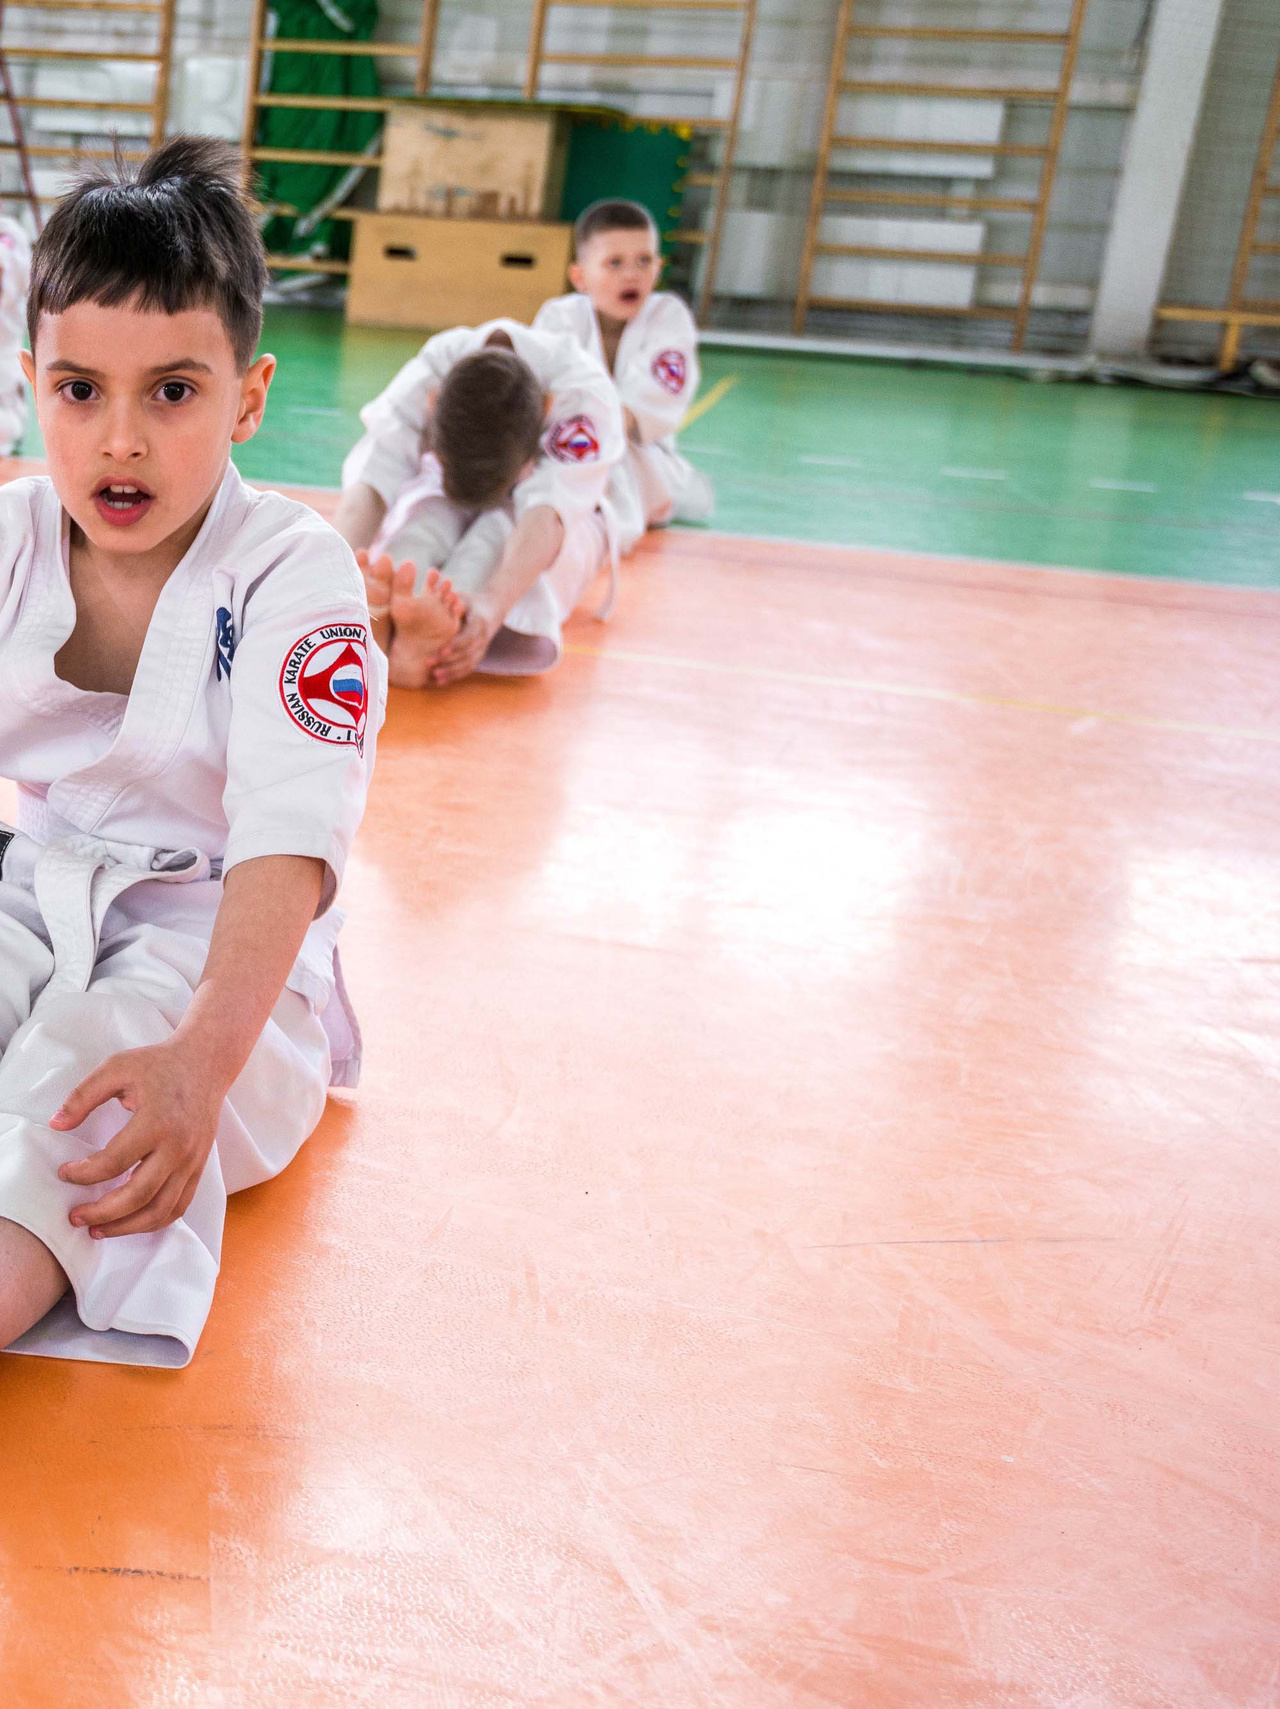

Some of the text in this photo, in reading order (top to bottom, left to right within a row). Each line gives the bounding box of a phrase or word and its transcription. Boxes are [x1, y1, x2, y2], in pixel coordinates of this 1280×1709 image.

[284, 627, 361, 737] RUSSIAN KARATE UNION
